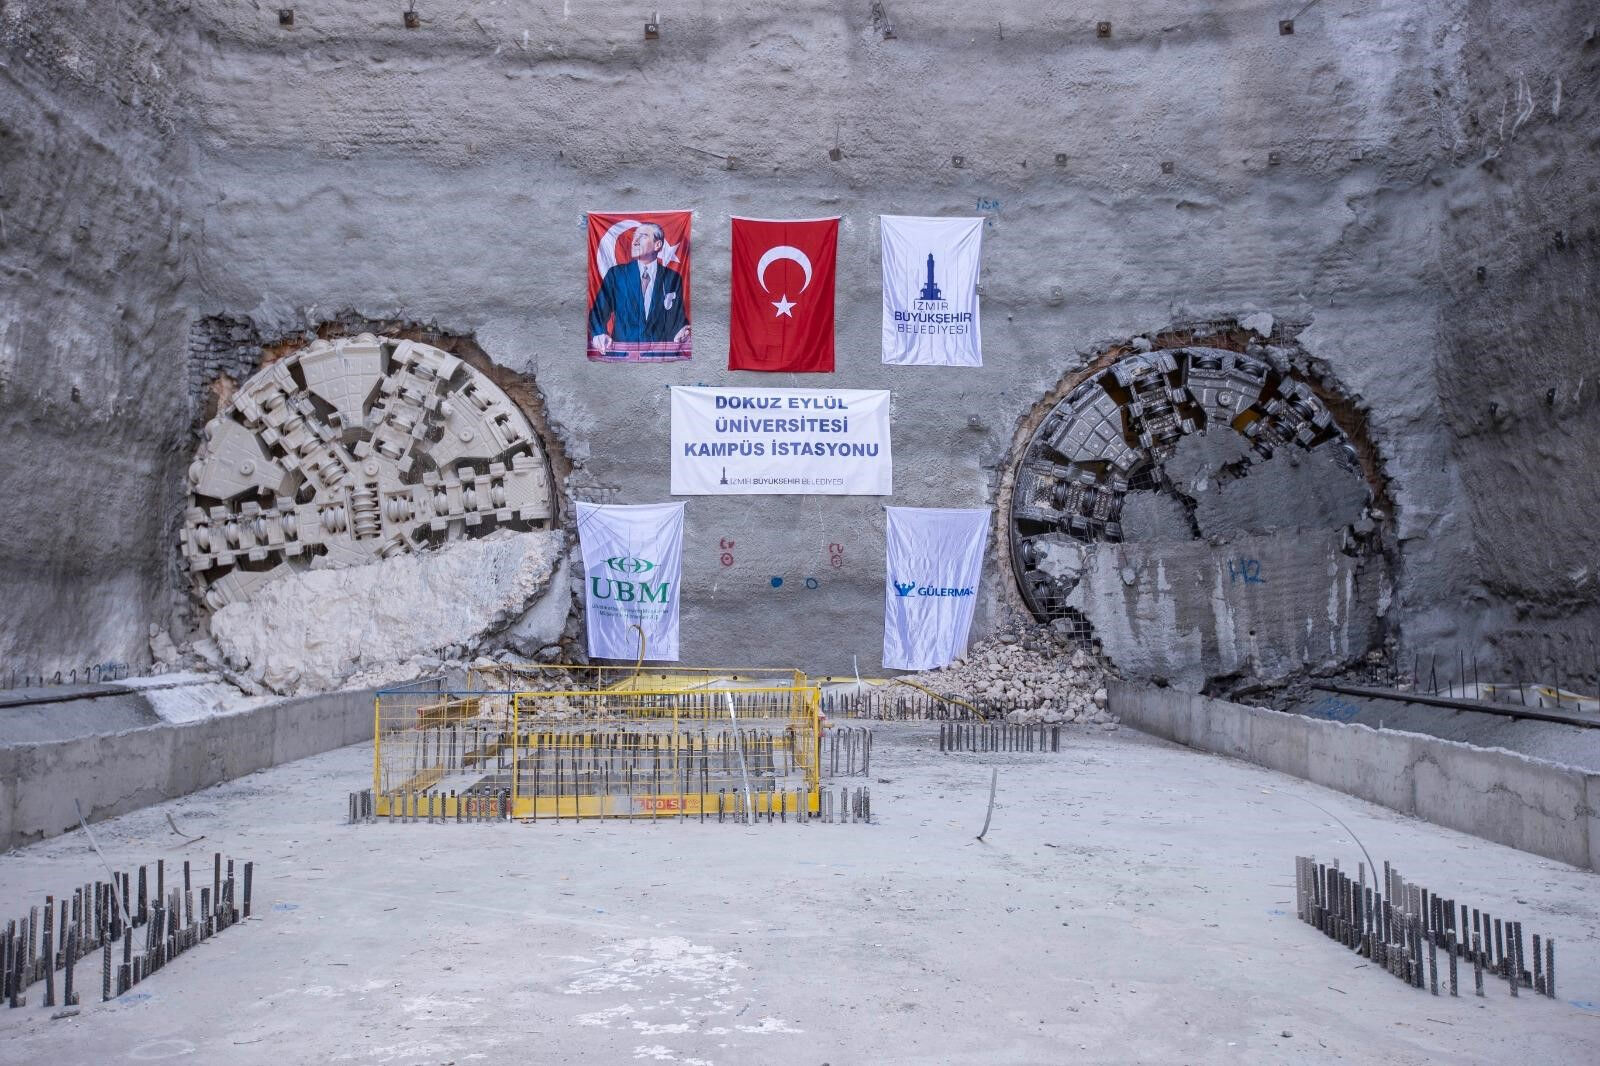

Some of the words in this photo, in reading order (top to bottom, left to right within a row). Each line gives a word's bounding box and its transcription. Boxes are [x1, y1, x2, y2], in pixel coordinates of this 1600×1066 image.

[913, 300, 949, 311] İZMİR
[894, 310, 972, 324] BÜYÜKŞEHİR
[897, 324, 968, 335] BELEDİYESİ
[715, 395, 782, 409] DOKUZ
[788, 395, 848, 409] EYLÜL
[715, 415, 848, 432] ÜNİVERSİTESİ
[684, 440, 765, 456] KAMPÜS
[772, 439, 879, 456] İSTASYONU
[590, 577, 670, 603] UBM
